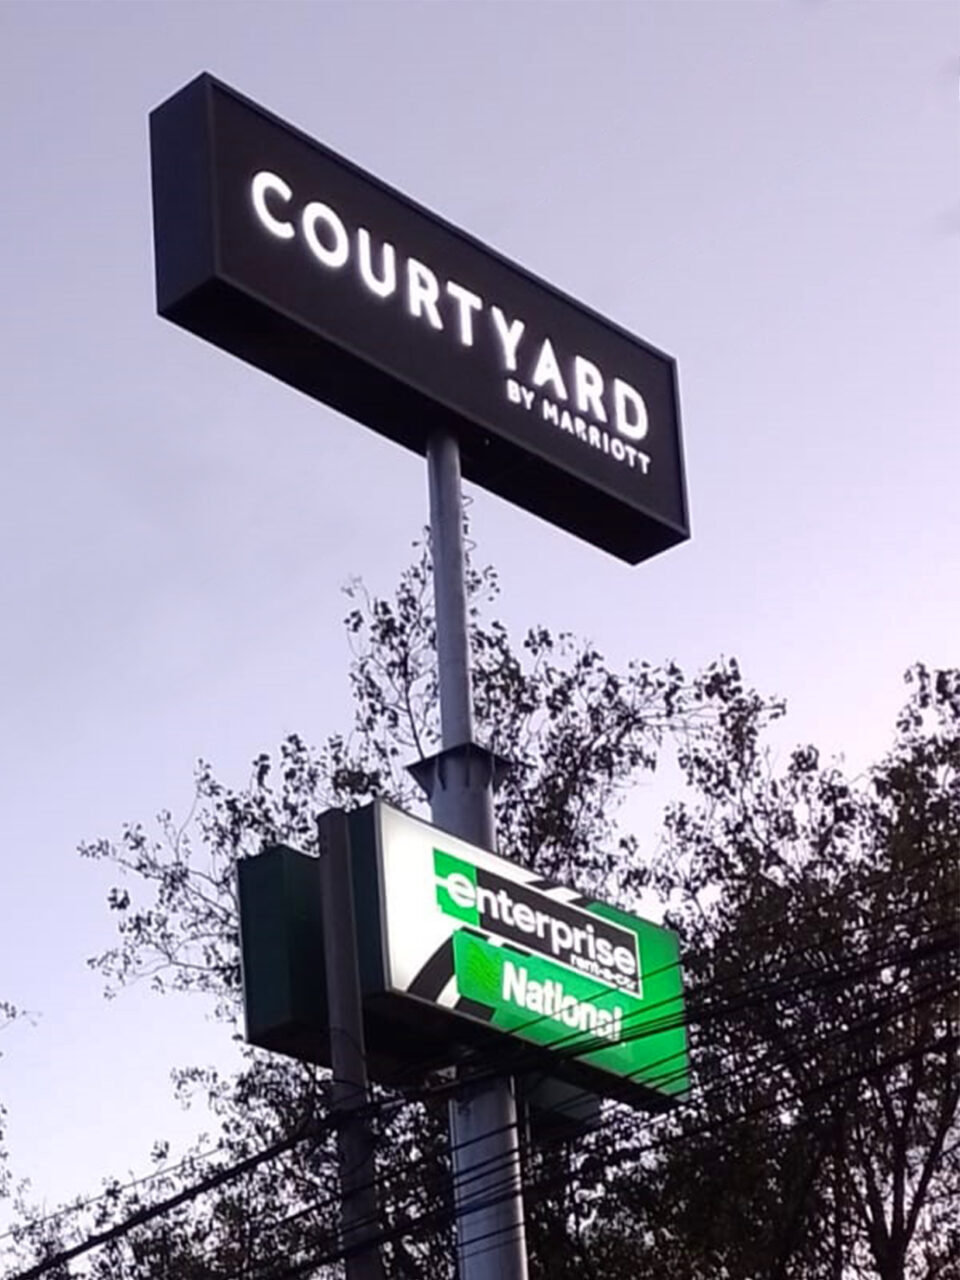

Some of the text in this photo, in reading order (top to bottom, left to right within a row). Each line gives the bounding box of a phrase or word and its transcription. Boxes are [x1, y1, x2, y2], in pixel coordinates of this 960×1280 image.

[251, 170, 649, 440] COURTYARD
[506, 378, 651, 475] BY MARRIOTT
[438, 872, 637, 976] enterprise
[501, 961, 623, 1042] National
